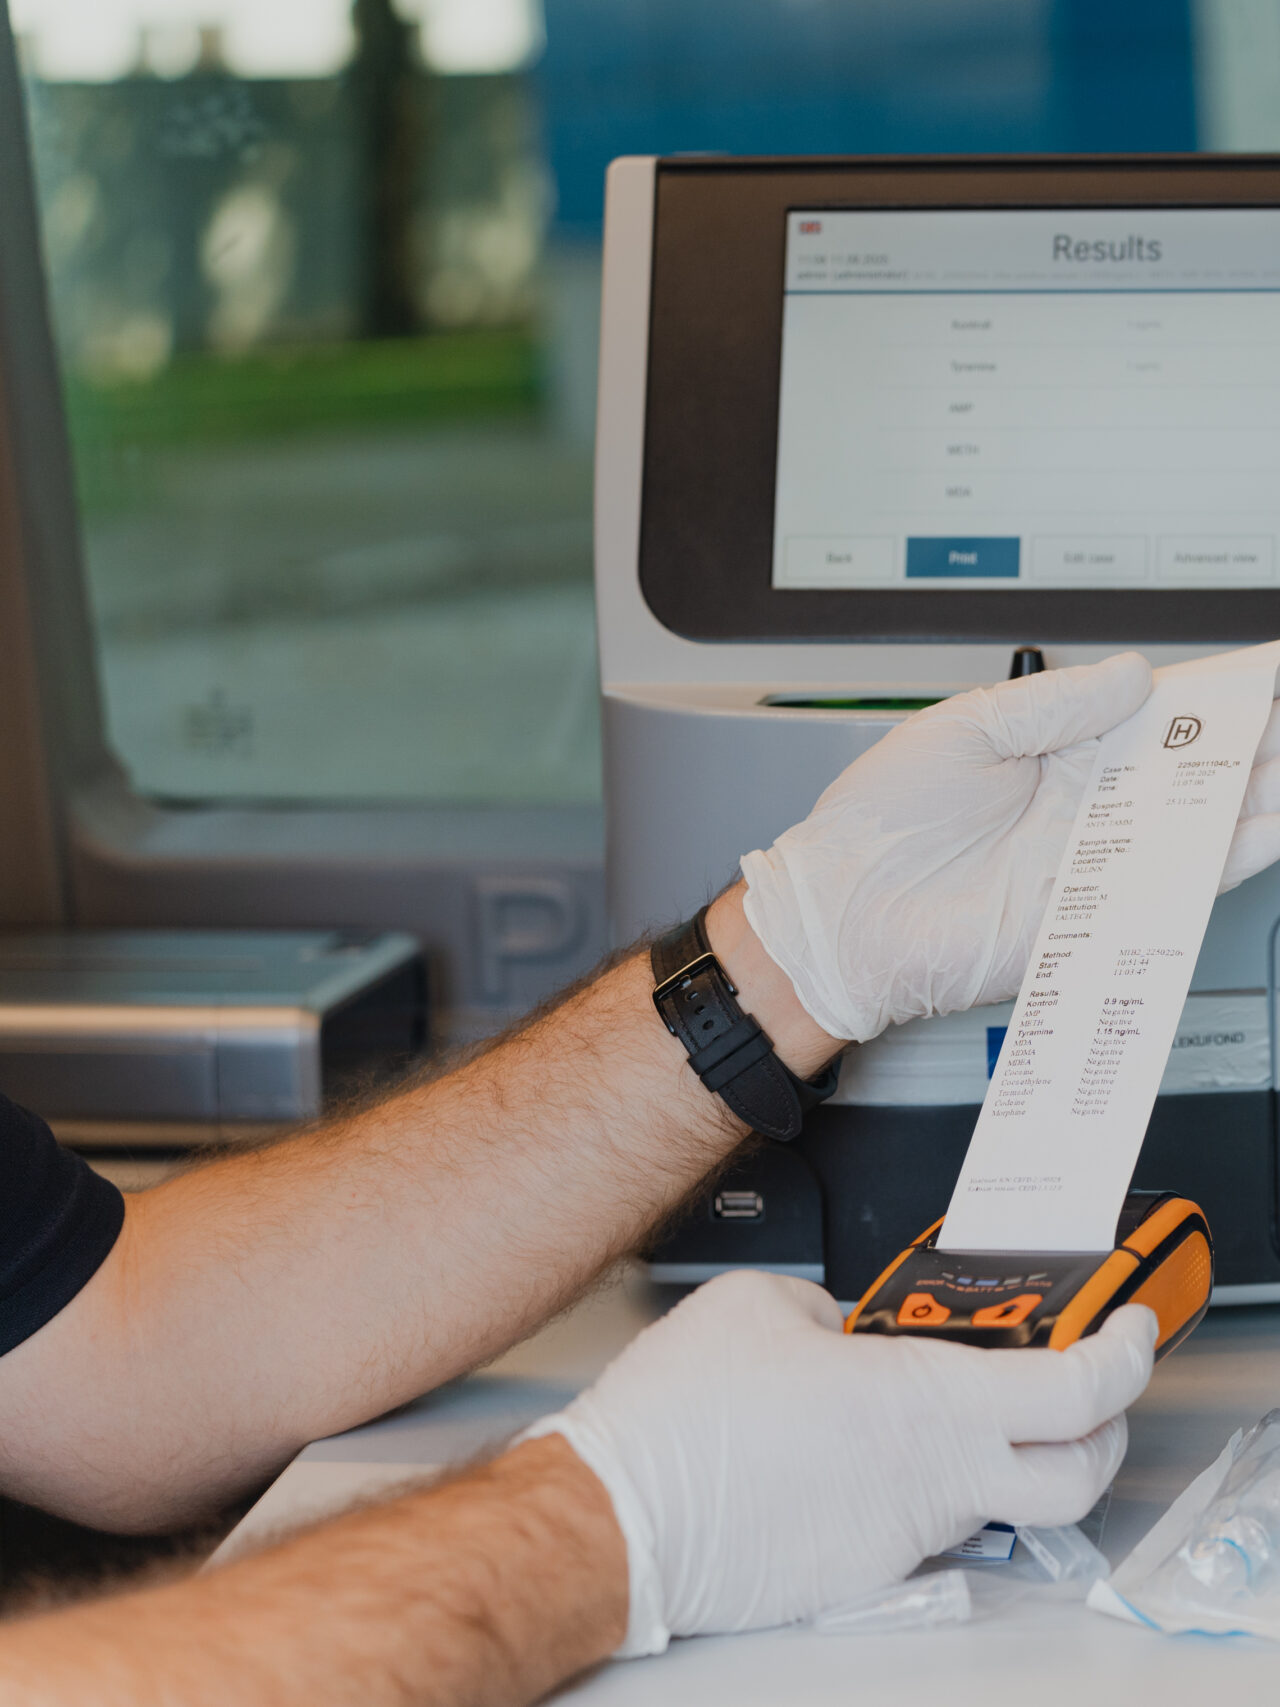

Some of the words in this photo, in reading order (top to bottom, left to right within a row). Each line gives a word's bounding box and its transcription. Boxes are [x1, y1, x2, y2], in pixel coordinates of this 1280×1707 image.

[1052, 234, 1162, 262] Results
[949, 551, 978, 565] Print
[1174, 552, 1228, 564] Advanced
[1090, 801, 1123, 812] Suspect
[1078, 838, 1108, 848] Sample
[1075, 847, 1112, 858] Appendix
[1063, 885, 1100, 894] Operator:
[1055, 913, 1093, 921] TALTECH
[1048, 932, 1093, 941] Comments:
[1042, 951, 1073, 960] Method:
[1038, 962, 1060, 970] Start:
[1035, 971, 1053, 979] End:
[1029, 989, 1062, 998] Results:
[1026, 999, 1059, 1008] Kontroll
[1104, 997, 1118, 1005] 0.9
[1118, 997, 1145, 1007] ng/mL
[1023, 1009, 1041, 1018] AMP
[1102, 1008, 1136, 1016] Negative
[1019, 1019, 1044, 1028] METH
[1099, 1018, 1133, 1026] Negative
[1017, 1028, 1054, 1038] Tyramine
[1096, 1027, 1113, 1035] 1.15
[1113, 1028, 1141, 1037] ng/mL
[1013, 1039, 1033, 1047] MDA
[1093, 1038, 1127, 1046] Negative
[1010, 1049, 1036, 1057] MDMA
[1089, 1048, 1124, 1056] Negative
[1086, 1058, 1121, 1066] Negative
[1004, 1068, 1034, 1077] Cocaine
[1083, 1067, 1118, 1076] Negative
[1001, 1077, 1053, 1087] Cocaethylene
[1079, 1077, 1114, 1086] Negative
[998, 1088, 1034, 1097] Tramadol
[1076, 1087, 1111, 1096] Negative
[994, 1098, 1026, 1107] Codeine
[1073, 1097, 1109, 1106] Negative
[991, 1108, 1026, 1118] Morphine
[1070, 1107, 1105, 1116] Negative
